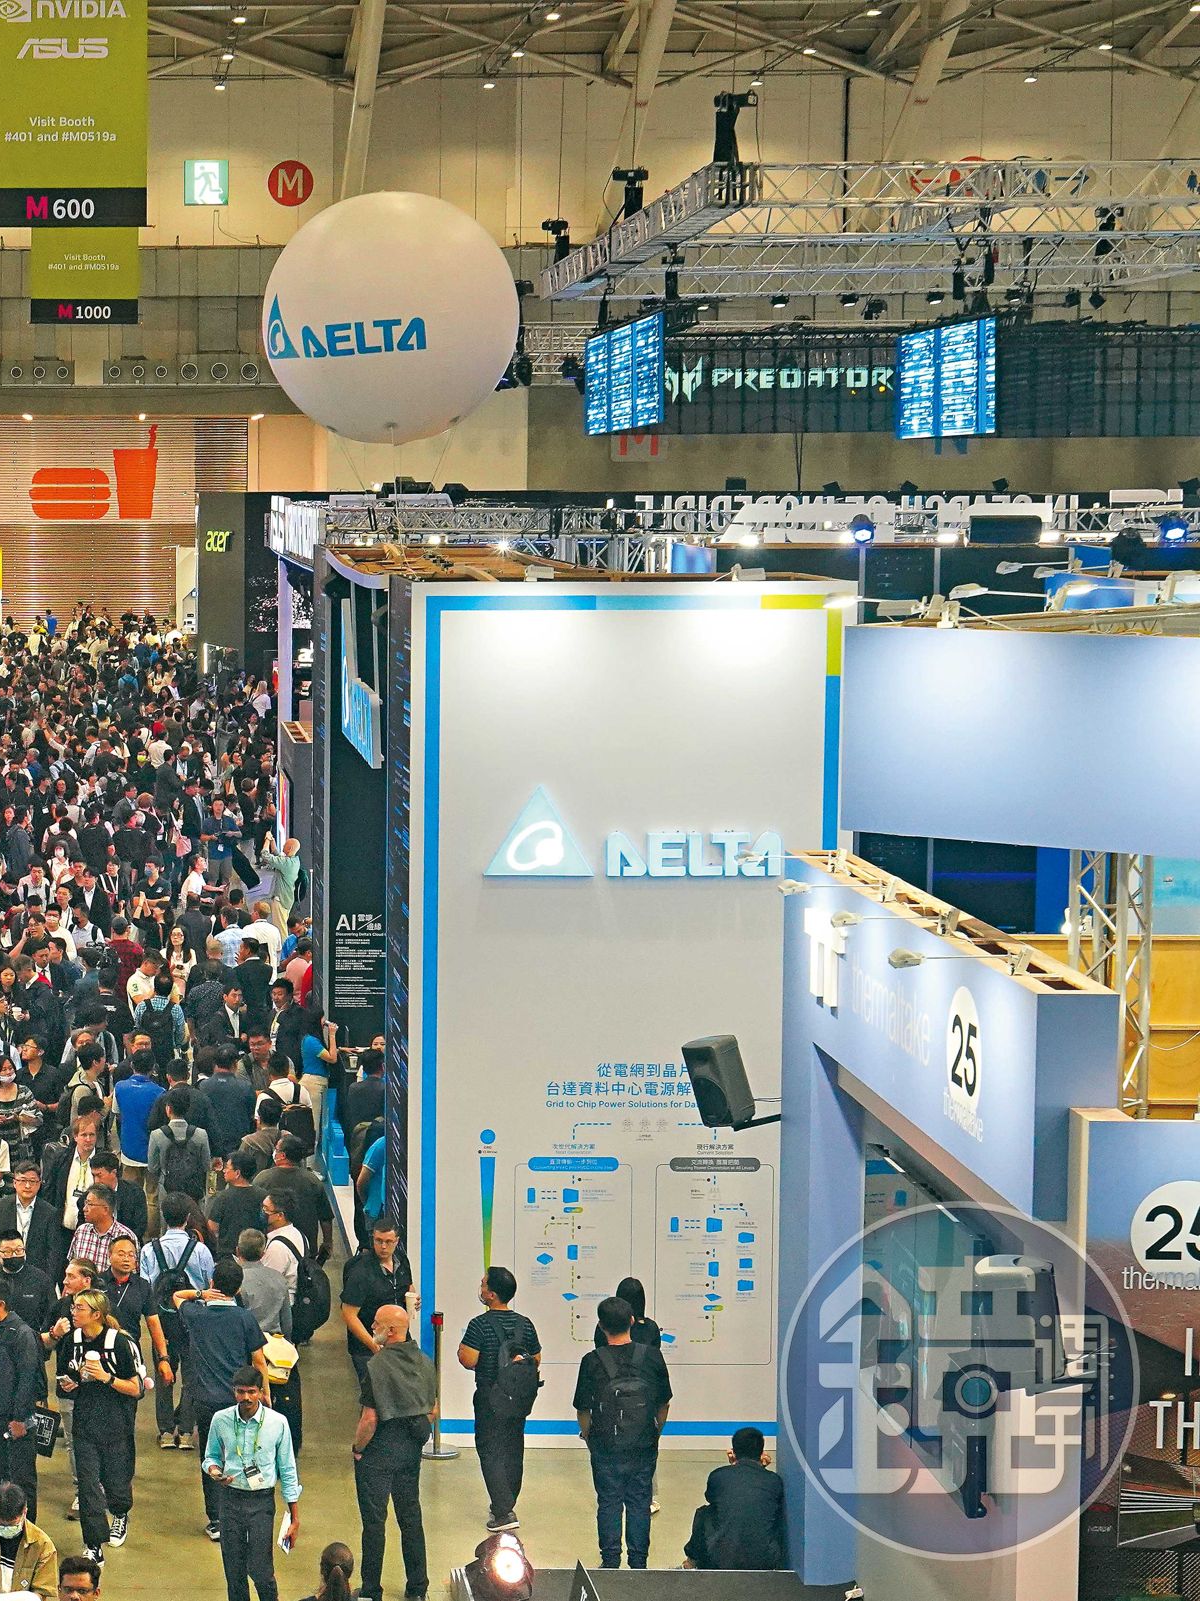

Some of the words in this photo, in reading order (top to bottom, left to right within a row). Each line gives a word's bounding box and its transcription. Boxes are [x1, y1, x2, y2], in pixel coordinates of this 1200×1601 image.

[16, 38, 108, 59] ASUS
[29, 116, 56, 127] Visit
[59, 116, 95, 127] Booth
[4, 131, 33, 142] #401
[37, 132, 59, 142] and
[61, 131, 117, 142] #M0519a
[276, 168, 304, 199] M
[26, 196, 49, 219] M
[52, 198, 95, 219] 600
[48, 262, 67, 271] #401
[68, 262, 83, 271] and
[63, 253, 82, 262] Visit
[83, 253, 106, 262] Booth
[57, 304, 73, 319] M
[75, 305, 111, 319] 1000
[301, 316, 427, 358] DELTA
[711, 366, 895, 389] PREDATOR
[205, 530, 231, 553] acer
[606, 830, 782, 877] DELTA
[336, 914, 357, 930] AI
[951, 1014, 977, 1097] 25
[546, 1081, 691, 1096] 台達資料中心電源解
[545, 1100, 564, 1108] Grid
[577, 1100, 597, 1109] Chip
[627, 1100, 668, 1108] Solutions
[670, 1100, 683, 1108] for
